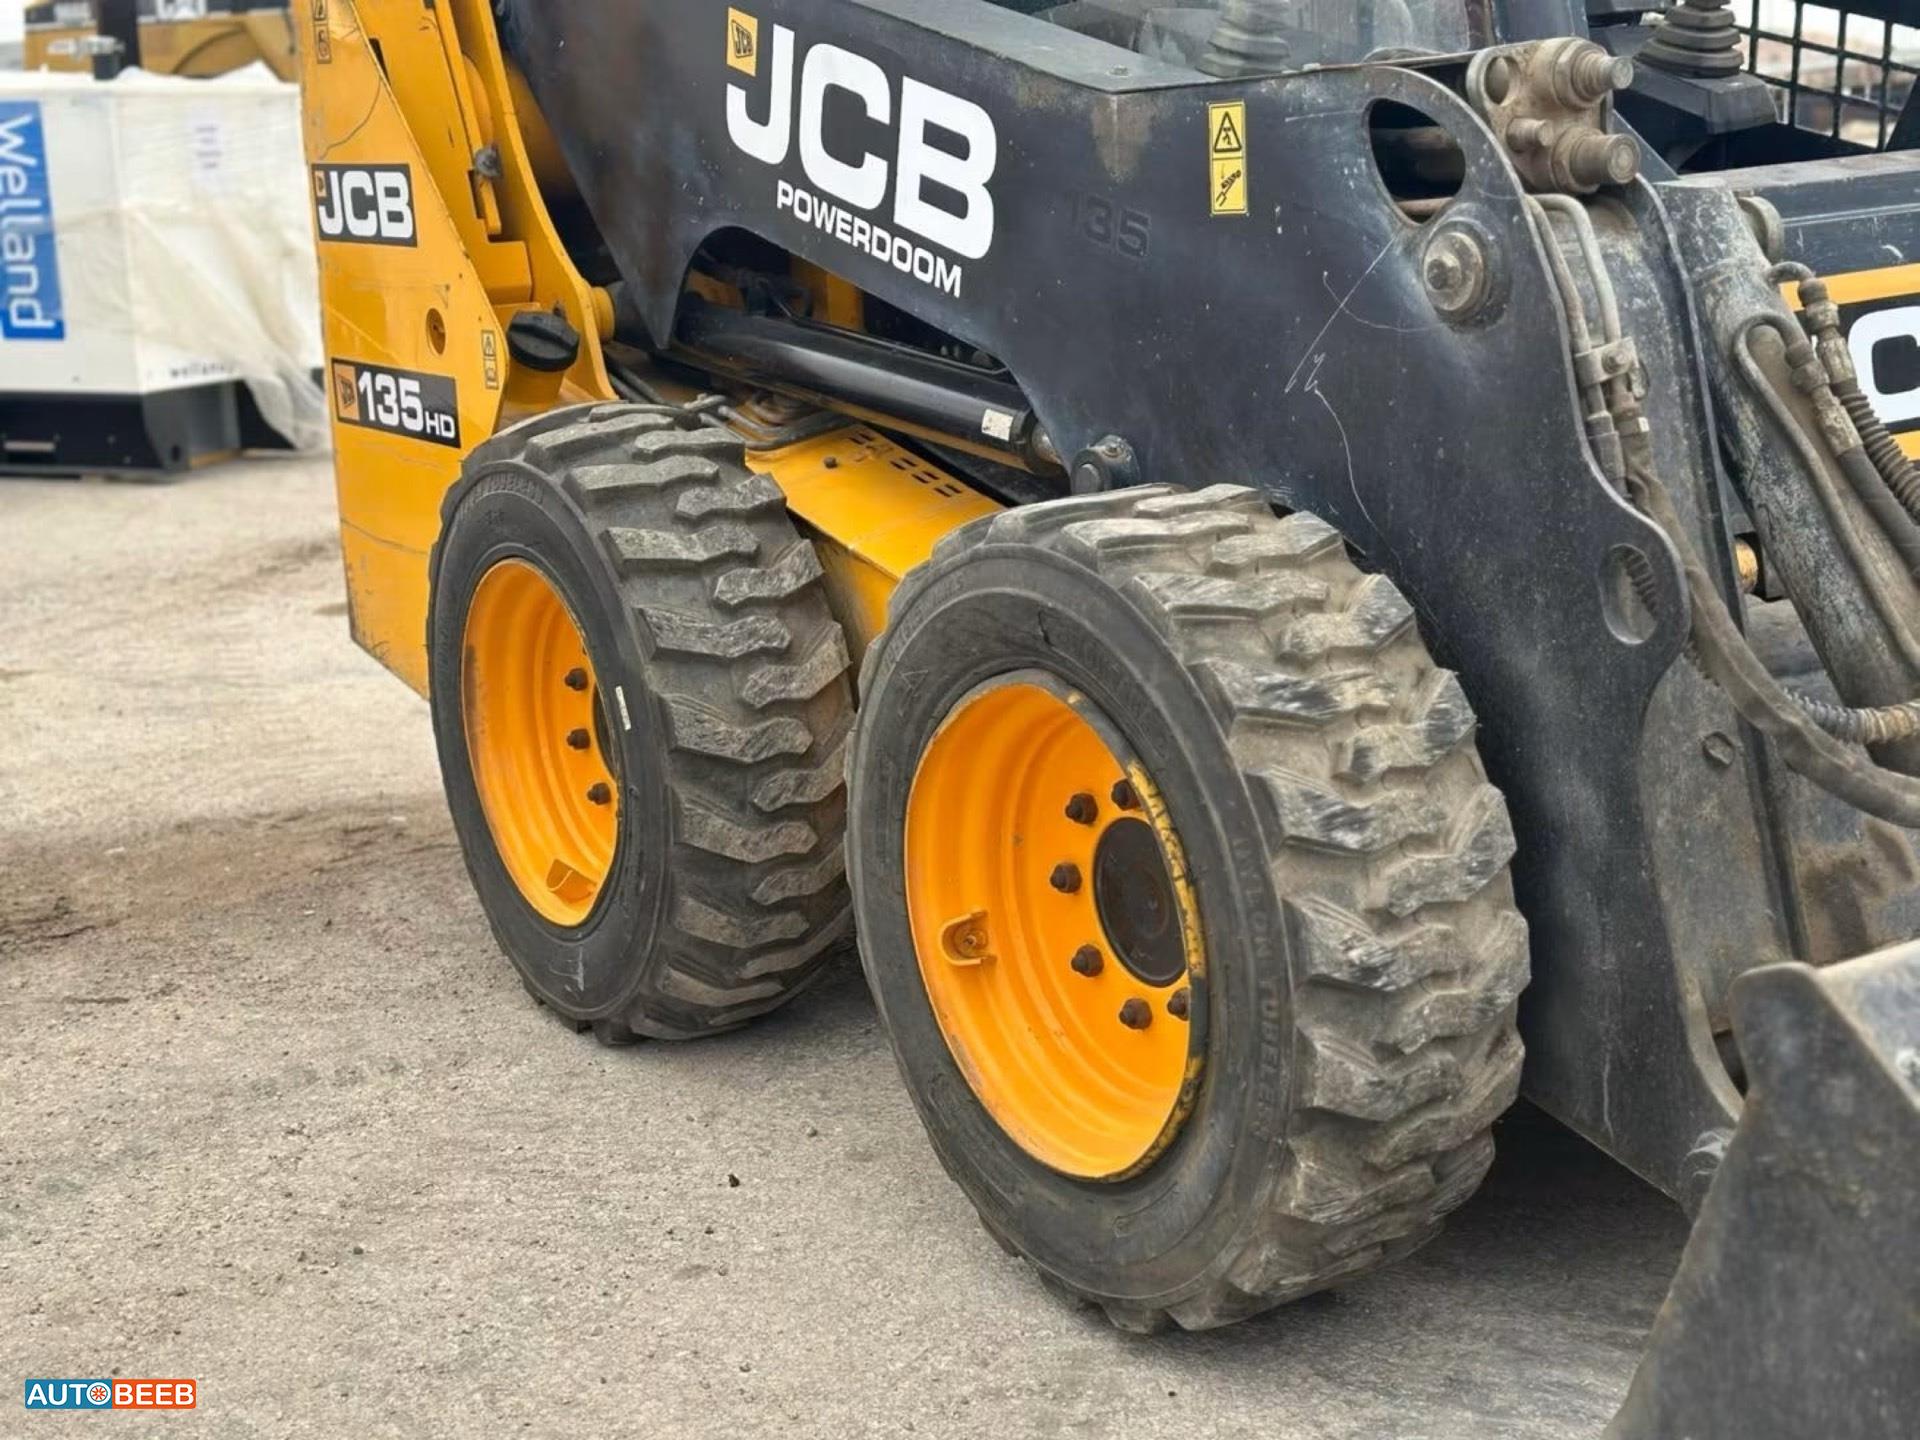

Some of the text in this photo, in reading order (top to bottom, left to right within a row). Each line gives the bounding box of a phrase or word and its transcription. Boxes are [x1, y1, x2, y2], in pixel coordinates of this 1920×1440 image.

[0, 113, 55, 328] Welland
[319, 170, 414, 238] JCB
[726, 23, 997, 259] JCB
[776, 179, 962, 298] POWERDOOM
